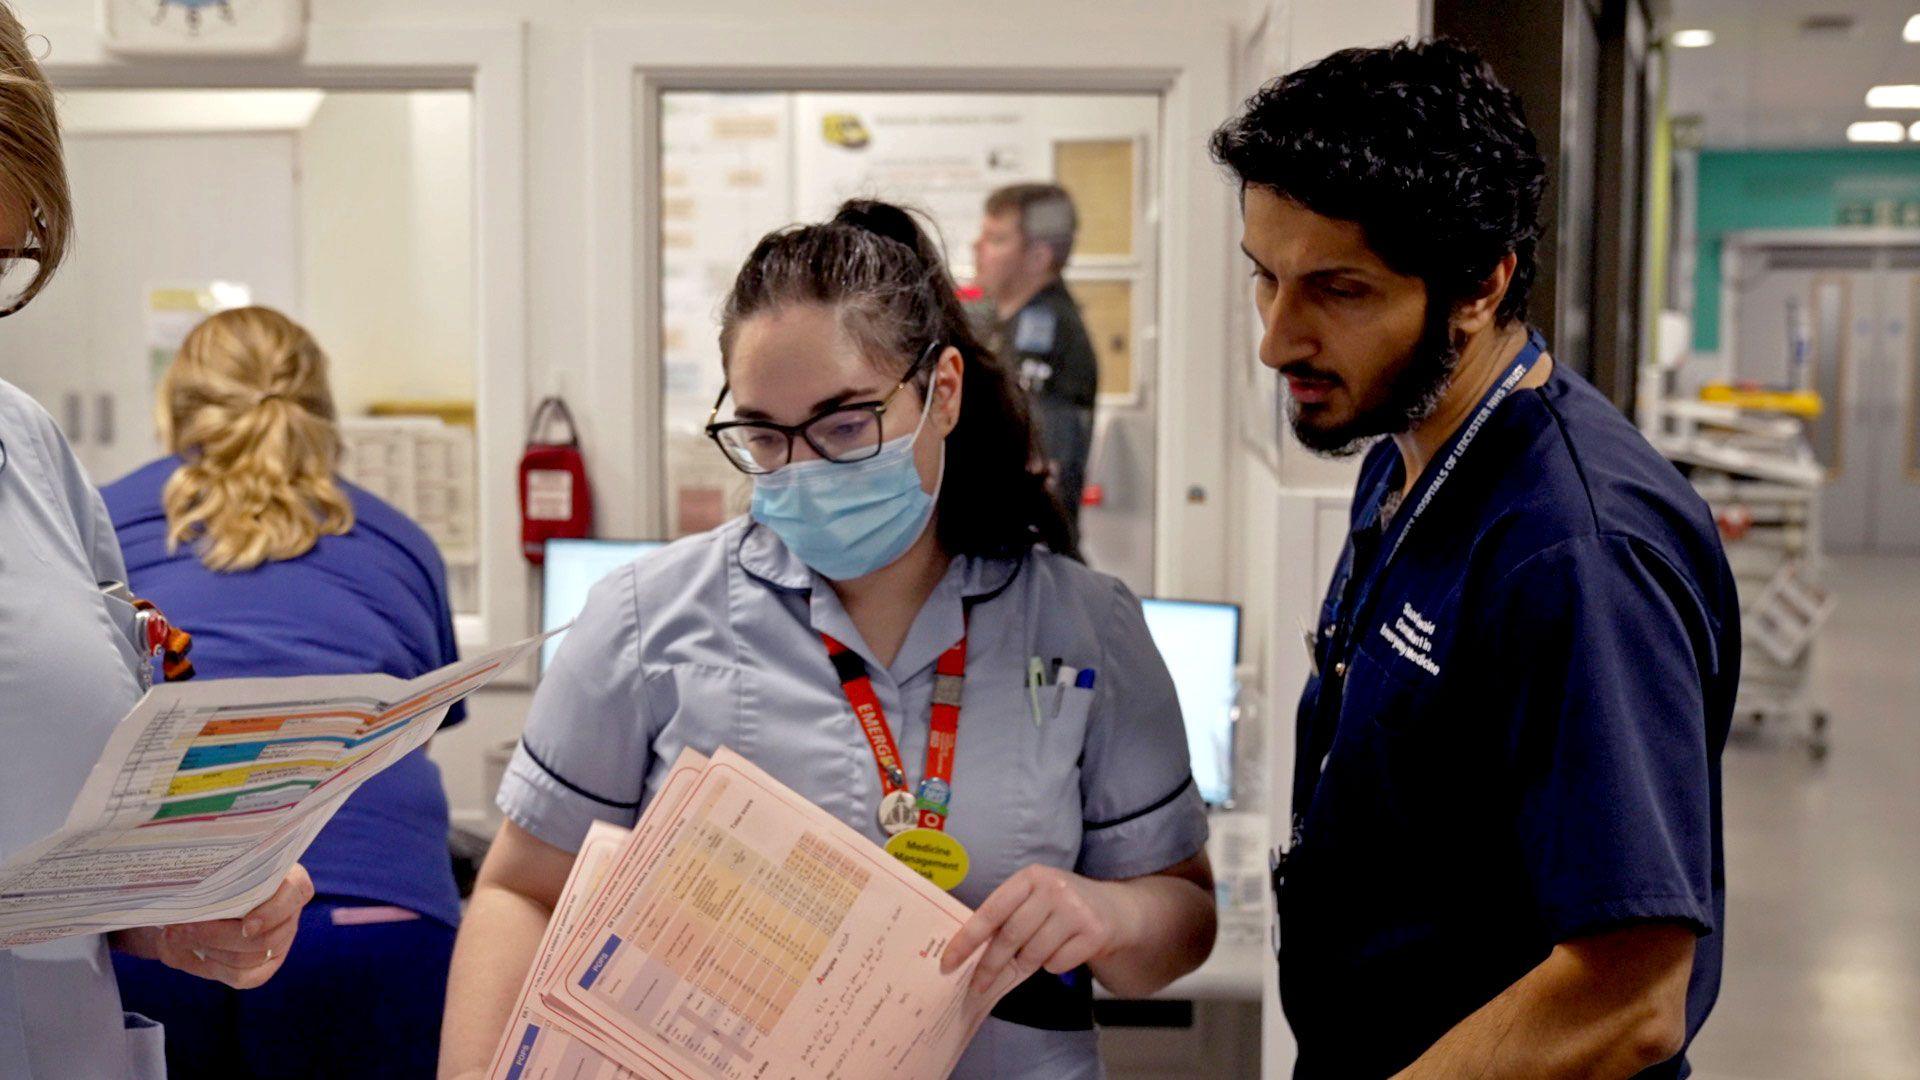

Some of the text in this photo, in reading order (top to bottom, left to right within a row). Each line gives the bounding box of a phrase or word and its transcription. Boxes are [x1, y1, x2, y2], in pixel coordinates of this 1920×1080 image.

[1444, 454, 1458, 470] OF
[1453, 406, 1491, 457] LEICESTER
[1486, 387, 1505, 409] NHS
[1501, 363, 1527, 390] TRUST
[1404, 646, 1440, 677] Medicine
[730, 798, 753, 829] Total score
[907, 840, 951, 857] Medicine
[817, 957, 838, 985] Allergies
